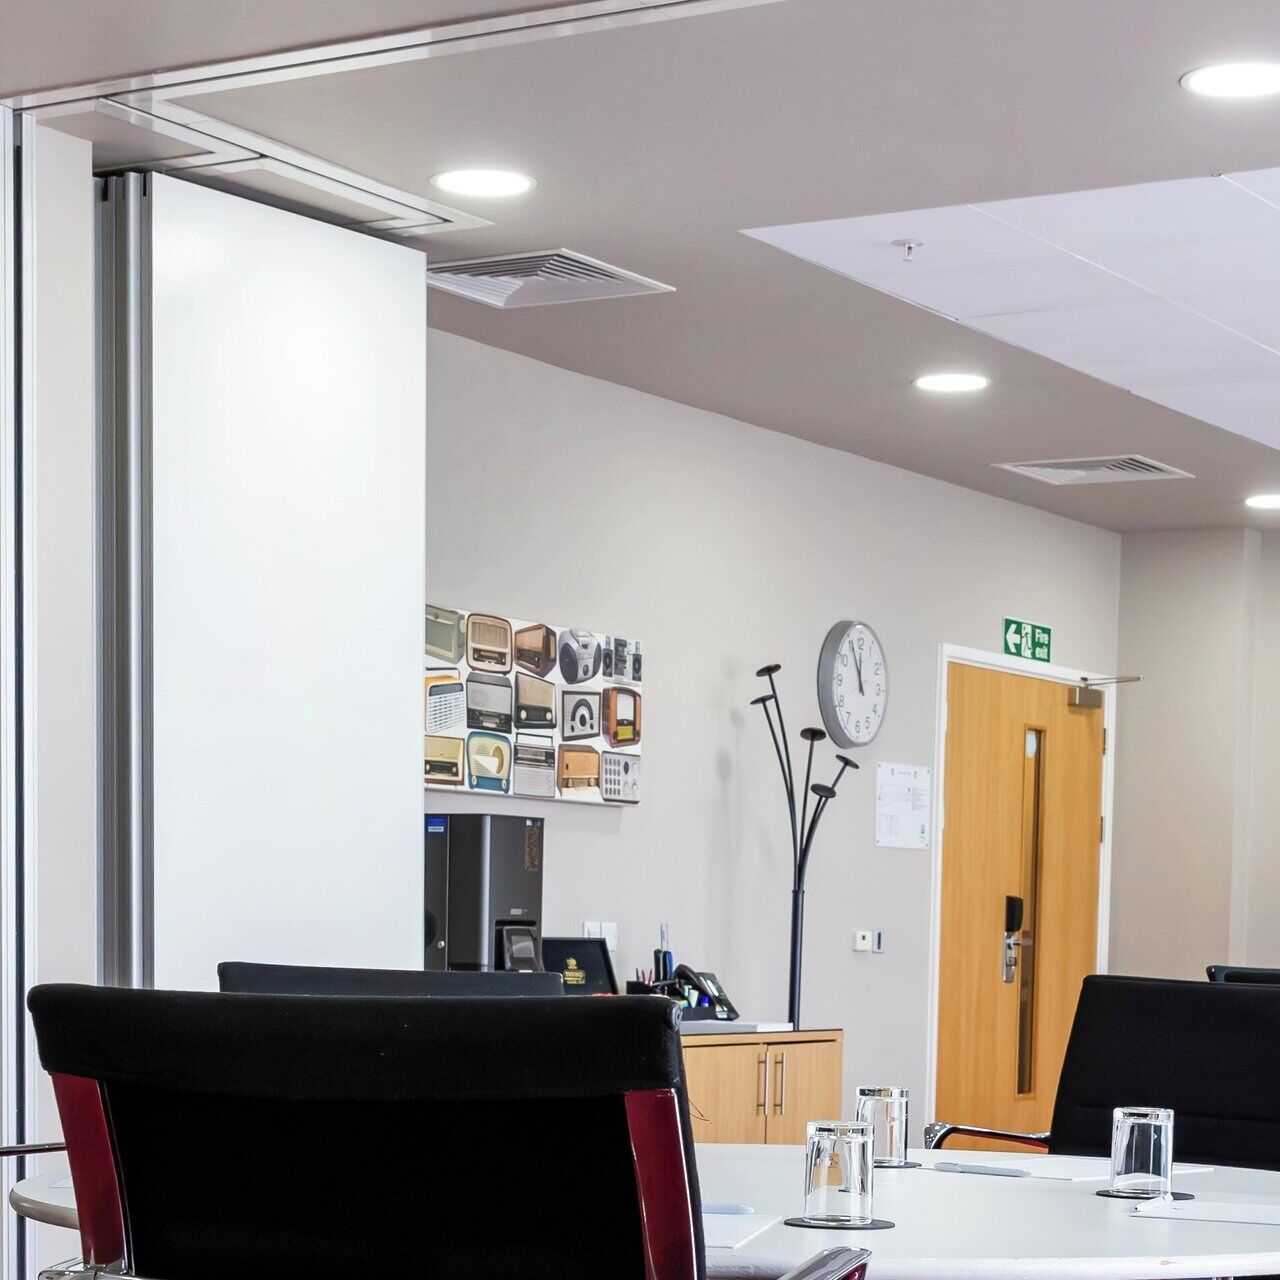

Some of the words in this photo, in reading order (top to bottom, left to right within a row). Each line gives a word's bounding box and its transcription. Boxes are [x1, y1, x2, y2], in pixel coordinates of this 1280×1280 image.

[857, 637, 865, 650] 12
[838, 653, 849, 667] 10
[874, 662, 881, 676] 2
[837, 673, 843, 687] 9
[875, 683, 881, 696] 3
[839, 694, 845, 708] 8
[872, 703, 878, 714] 4
[846, 711, 852, 725] 7
[865, 716, 871, 730] 5
[855, 720, 861, 733] 6
